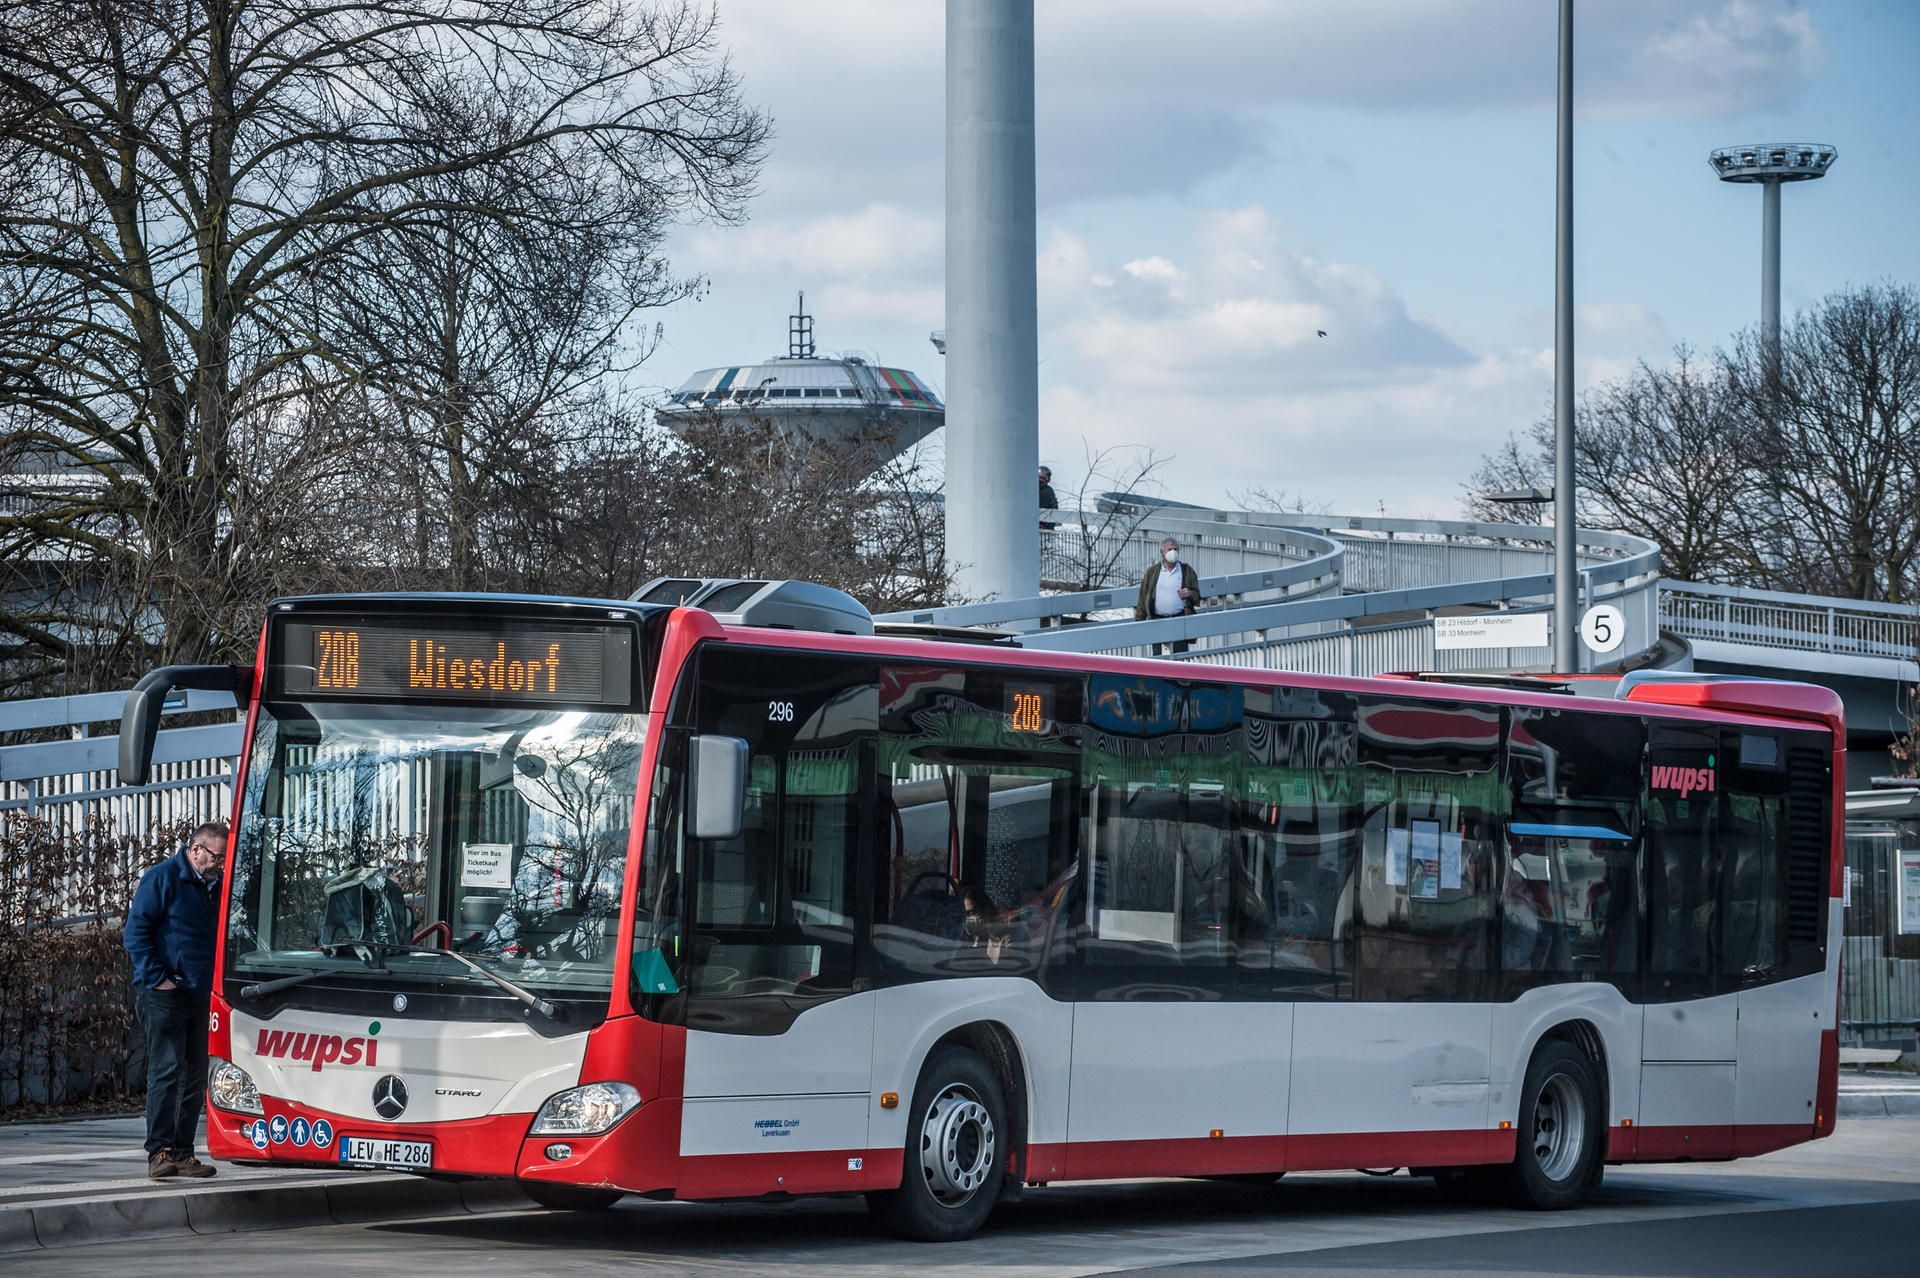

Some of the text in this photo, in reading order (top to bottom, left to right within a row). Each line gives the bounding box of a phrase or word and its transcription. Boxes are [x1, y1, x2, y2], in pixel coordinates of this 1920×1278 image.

[1457, 629, 1486, 637] Monheim
[1594, 615, 1611, 643] 5
[319, 631, 560, 692] 208 Wiesdorf
[768, 701, 794, 721] 296
[1013, 694, 1041, 731] 208
[1651, 755, 1715, 799] wupsi
[467, 859, 499, 867] Ticketkauf
[255, 1021, 381, 1072] wupsi
[435, 1089, 482, 1097] CITARO
[761, 1129, 791, 1137] Leverkusen
[349, 1141, 429, 1164] LEV HE 286
